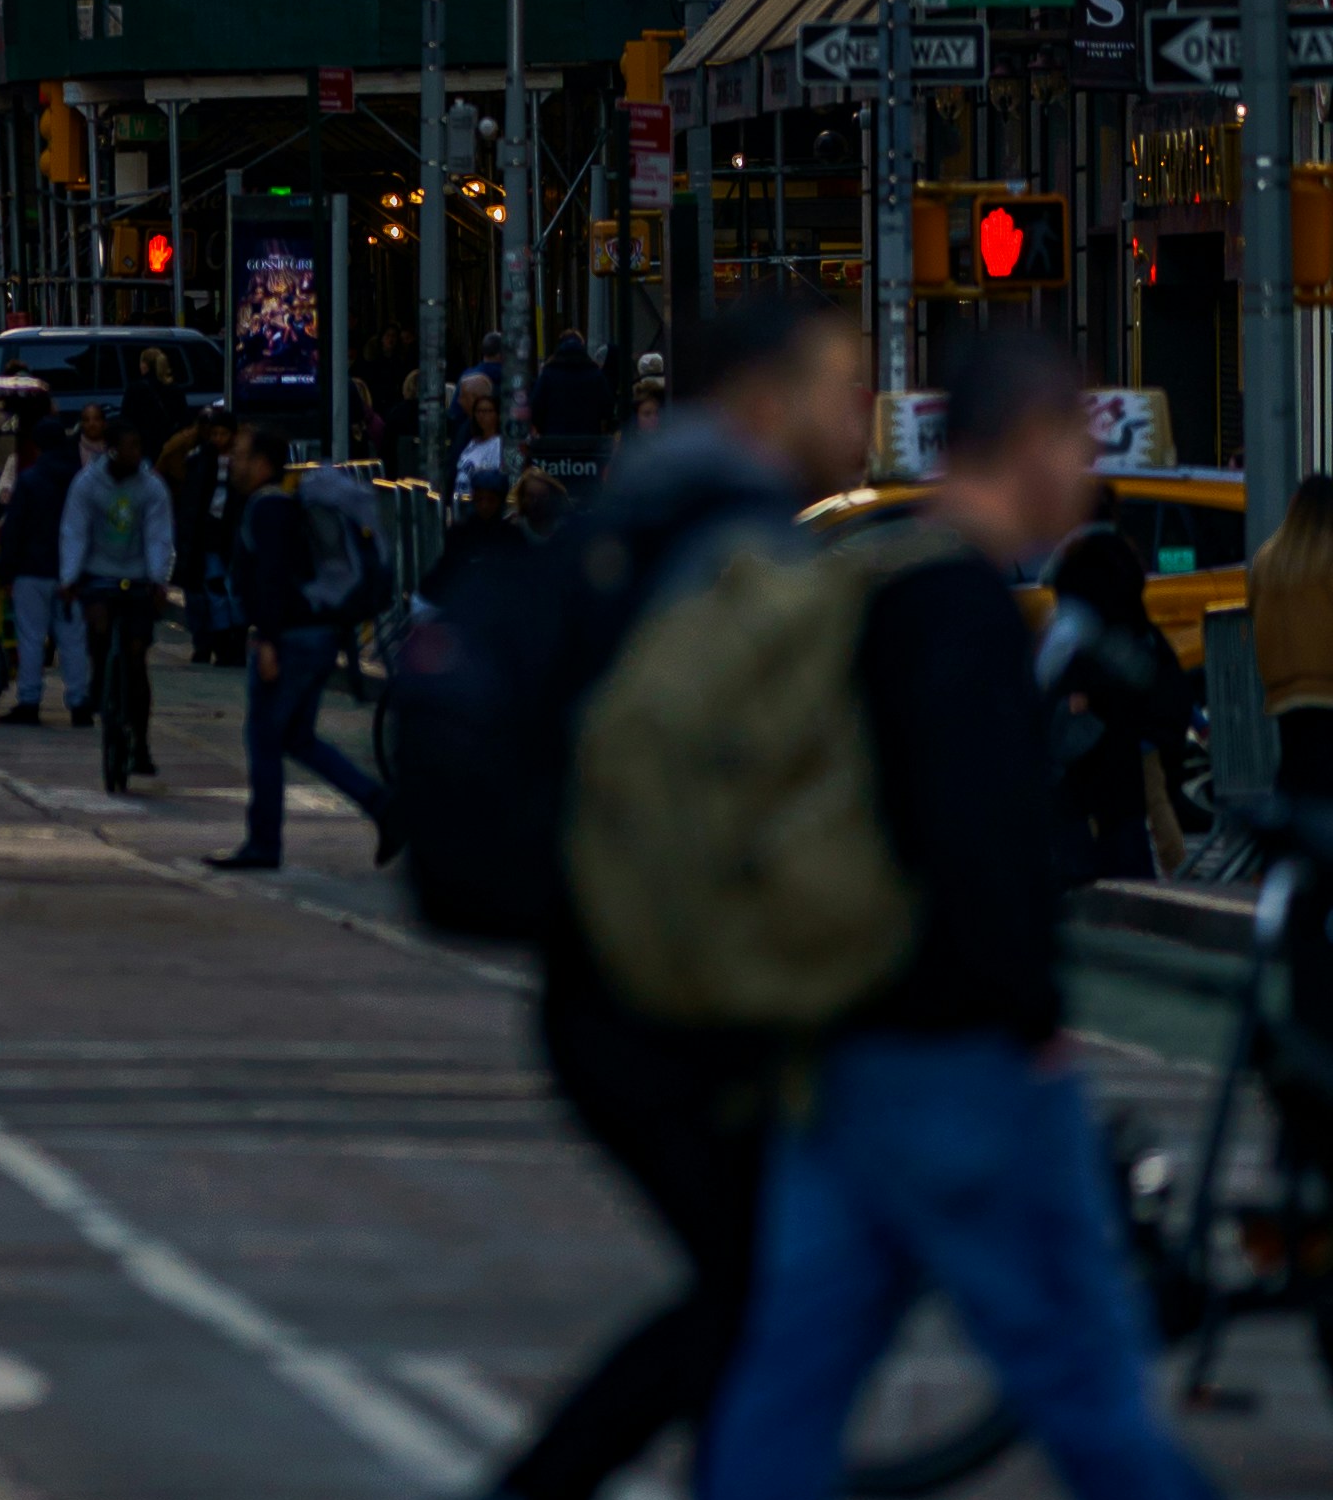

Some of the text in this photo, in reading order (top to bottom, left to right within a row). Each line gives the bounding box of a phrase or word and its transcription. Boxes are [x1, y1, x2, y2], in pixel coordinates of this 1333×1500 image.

[824, 35, 968, 68] ONE WAY
[1074, 39, 1136, 51] METROPOLITAN
[1086, 49, 1124, 59] FINE ART
[133, 118, 147, 136] W
[246, 257, 288, 271] GOSSIP
